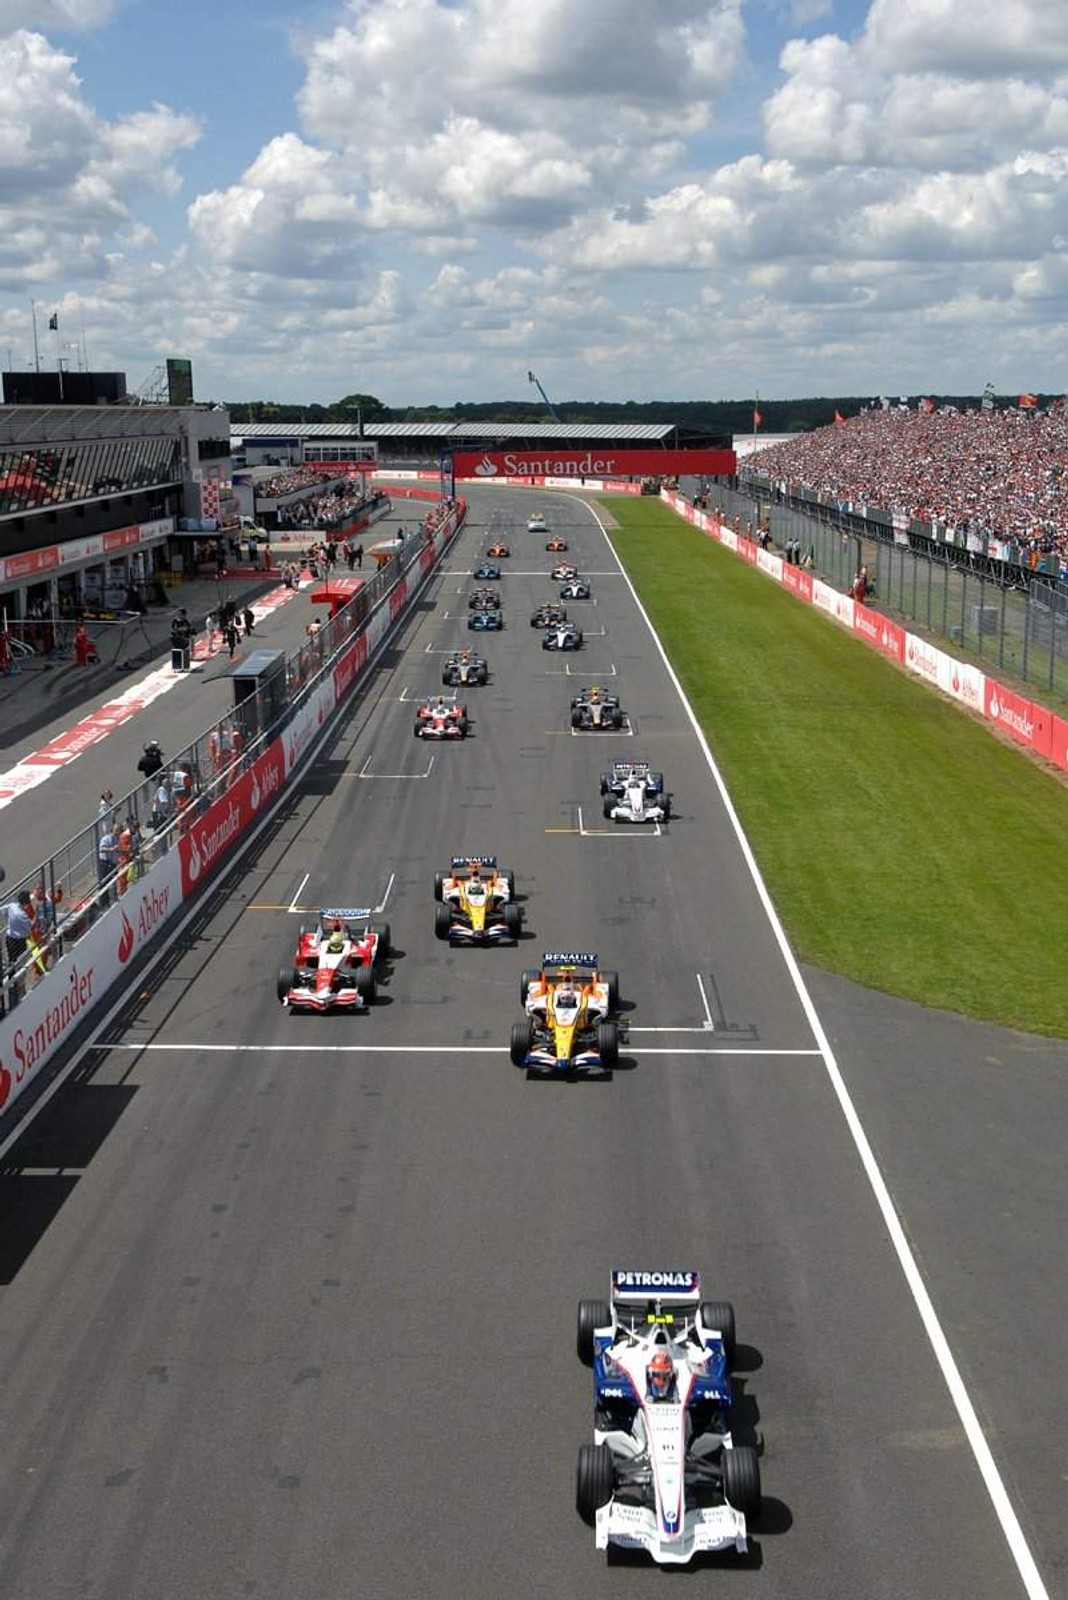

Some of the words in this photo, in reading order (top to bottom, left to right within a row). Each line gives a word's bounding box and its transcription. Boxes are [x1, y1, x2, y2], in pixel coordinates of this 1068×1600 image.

[504, 453, 615, 475] Santander
[1000, 697, 1034, 739] Santander
[200, 799, 241, 868] Santander
[260, 763, 280, 799] Abbey
[545, 953, 597, 961] RENAULT
[13, 964, 95, 1083] Santander
[137, 885, 170, 942] Abbey
[617, 1271, 693, 1286] PETRONAS
